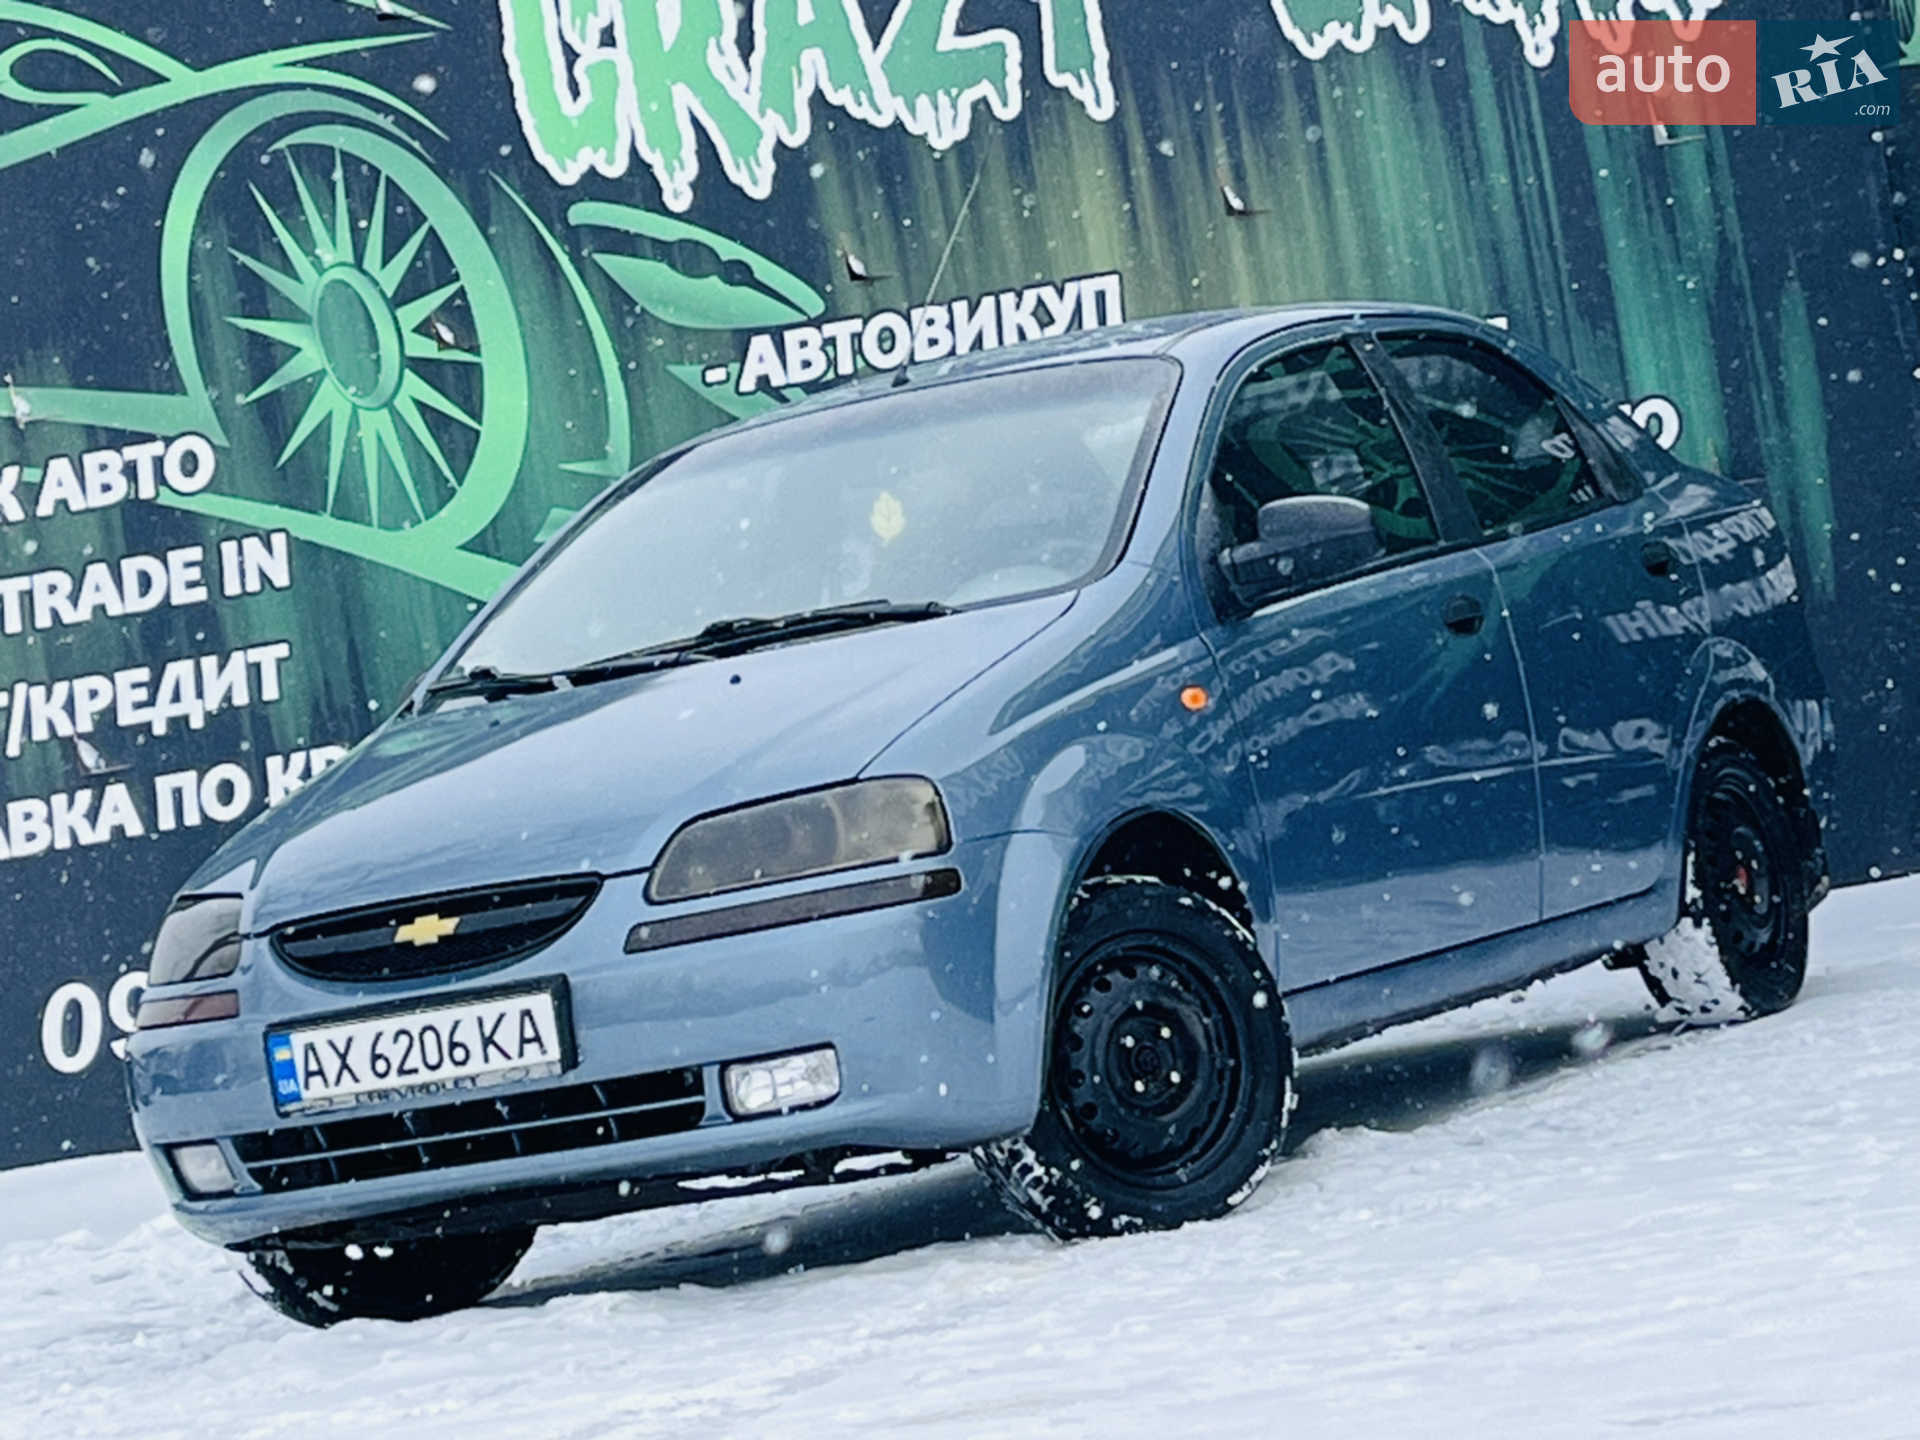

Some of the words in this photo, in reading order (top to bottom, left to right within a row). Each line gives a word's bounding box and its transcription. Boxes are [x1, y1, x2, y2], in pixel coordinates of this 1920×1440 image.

[35, 434, 216, 518] АВТО
[0, 546, 208, 635] TRADE
[220, 531, 291, 598] IN
[0, 642, 290, 758] /КРЕДИТ
[0, 783, 145, 861] ВКА
[154, 763, 251, 831] ПО
[278, 1078, 299, 1095] UA
[303, 1036, 360, 1091] AX
[370, 1019, 470, 1079] 6206
[477, 1009, 547, 1064] KA
